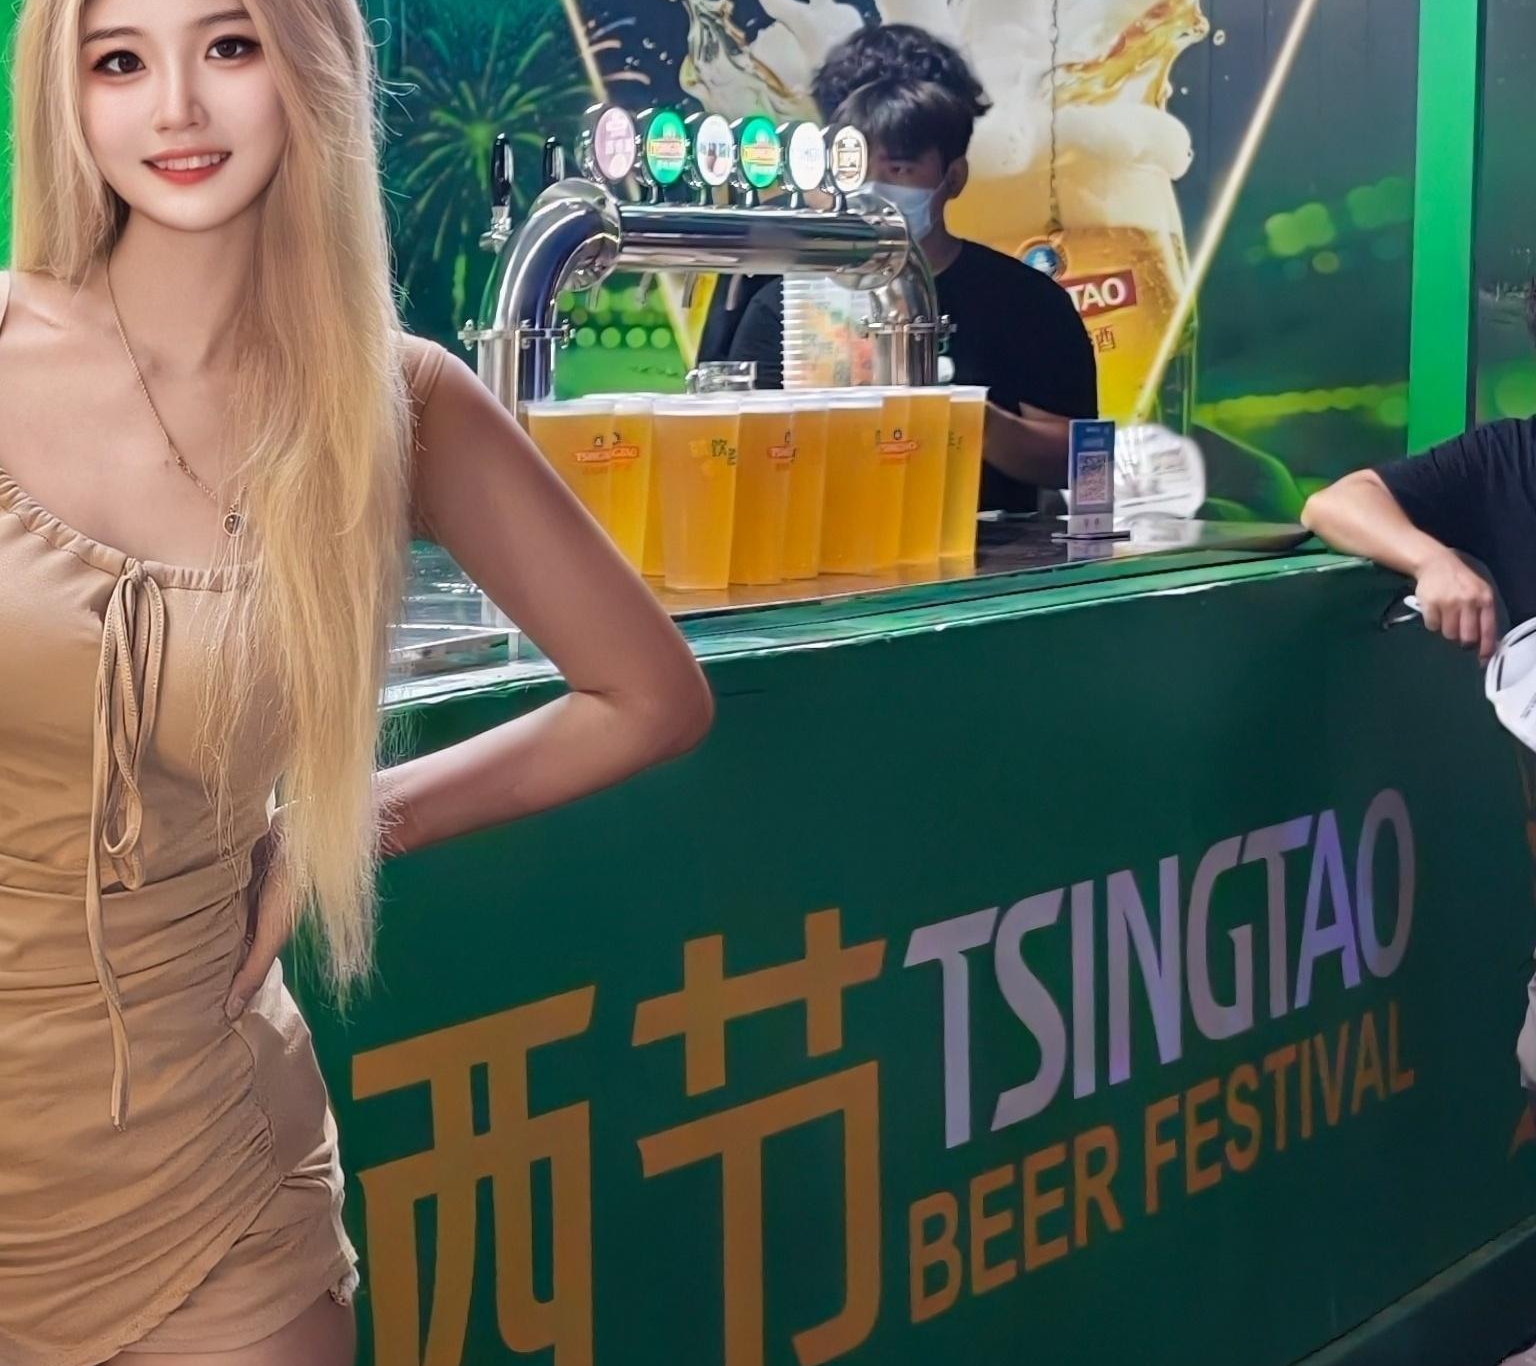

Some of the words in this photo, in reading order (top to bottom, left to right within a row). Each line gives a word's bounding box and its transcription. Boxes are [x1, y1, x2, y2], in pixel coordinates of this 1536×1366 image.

[903, 788, 1417, 1149] TSINGTAO
[908, 1125, 1123, 1325] BEER
[1145, 999, 1416, 1215] FESTIVAL
